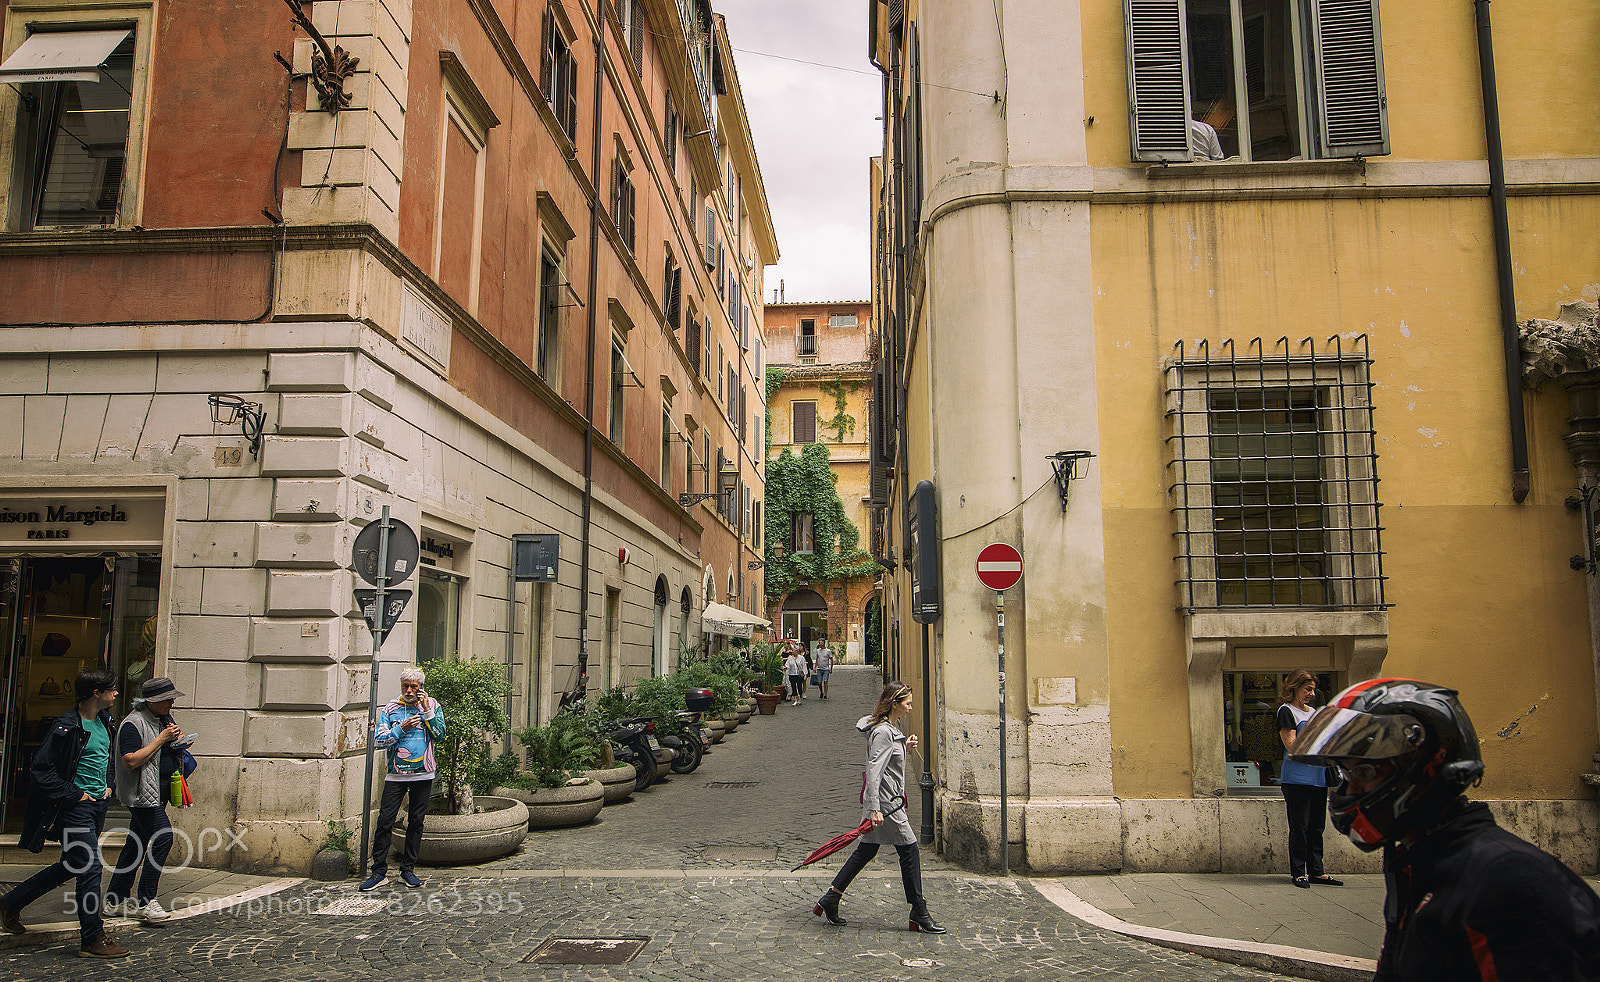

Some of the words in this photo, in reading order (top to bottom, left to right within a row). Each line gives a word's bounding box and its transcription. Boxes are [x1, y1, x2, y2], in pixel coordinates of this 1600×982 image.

[217, 449, 241, 464] 49
[0, 506, 40, 523] ison
[45, 504, 127, 526] Margiela
[27, 530, 69, 539] PARIS
